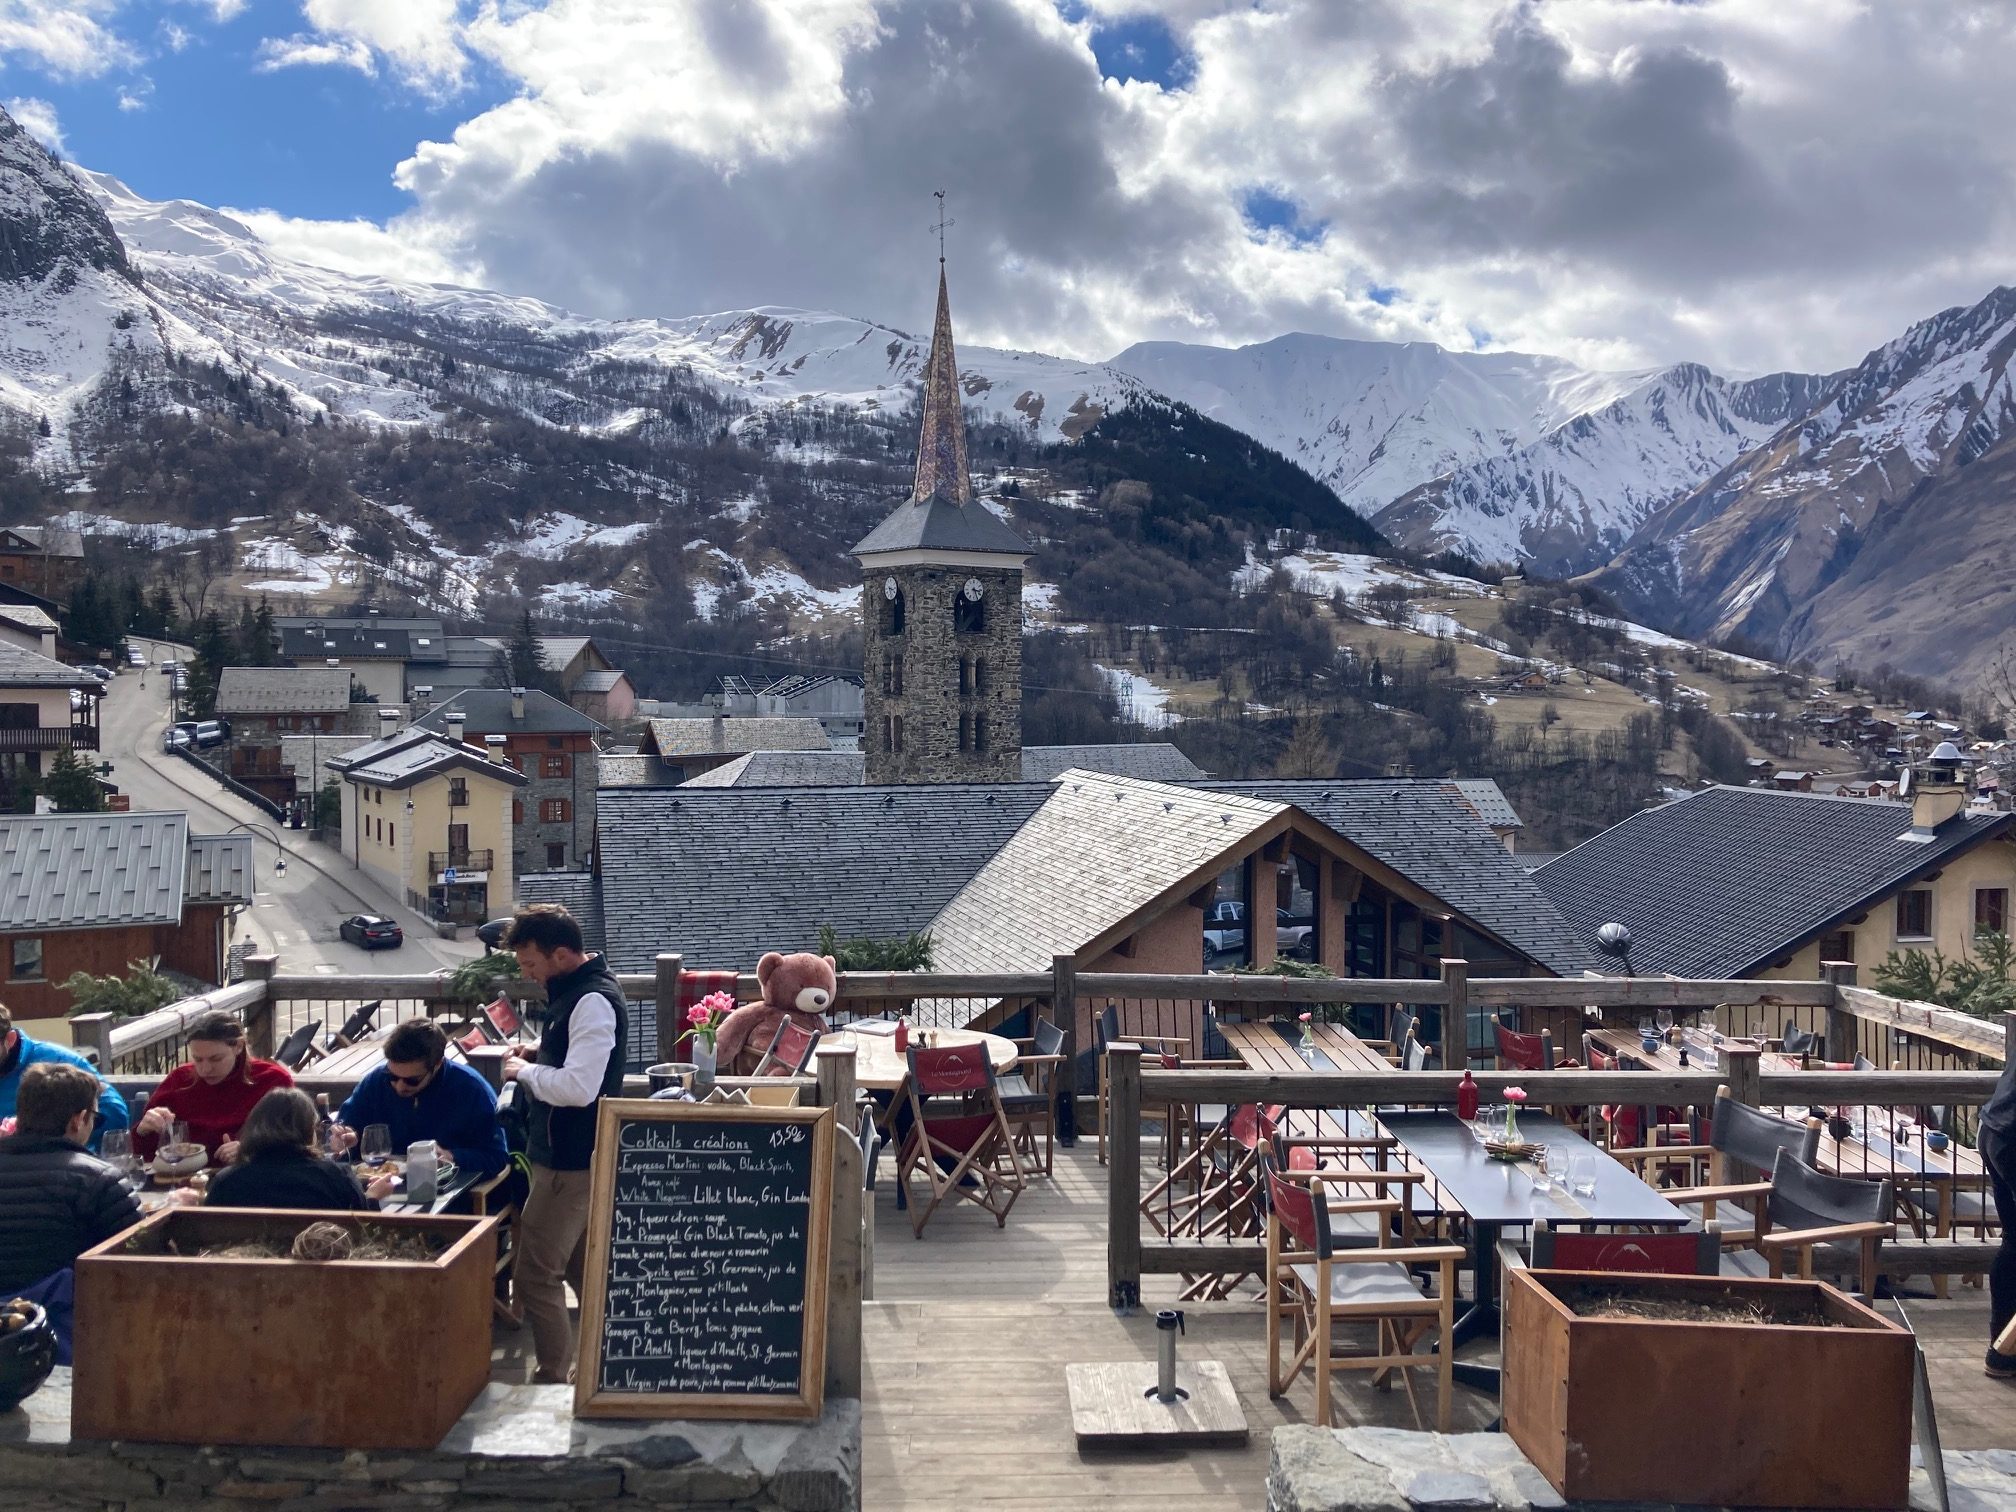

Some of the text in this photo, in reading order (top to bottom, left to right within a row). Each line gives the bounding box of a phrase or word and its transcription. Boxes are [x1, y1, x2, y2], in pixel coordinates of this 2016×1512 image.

[620, 1123, 682, 1150] Coktails
[693, 1131, 749, 1150] créations
[740, 1157, 766, 1171] Black
[694, 1184, 721, 1204] Lillet
[727, 1186, 759, 1207] blanc,
[761, 1185, 781, 1204] Gin
[640, 1207, 668, 1230] liqueur
[684, 1225, 704, 1242] Gin
[706, 1225, 735, 1241] Black
[770, 1229, 784, 1247] jus
[788, 1225, 800, 1240] de
[766, 1264, 781, 1283] jus
[785, 1261, 797, 1275] de
[658, 1300, 679, 1316] Gin
[722, 1297, 732, 1314] la
[761, 1298, 786, 1315] citron
[644, 1321, 664, 1336] Rue
[706, 1317, 727, 1334] tonic
